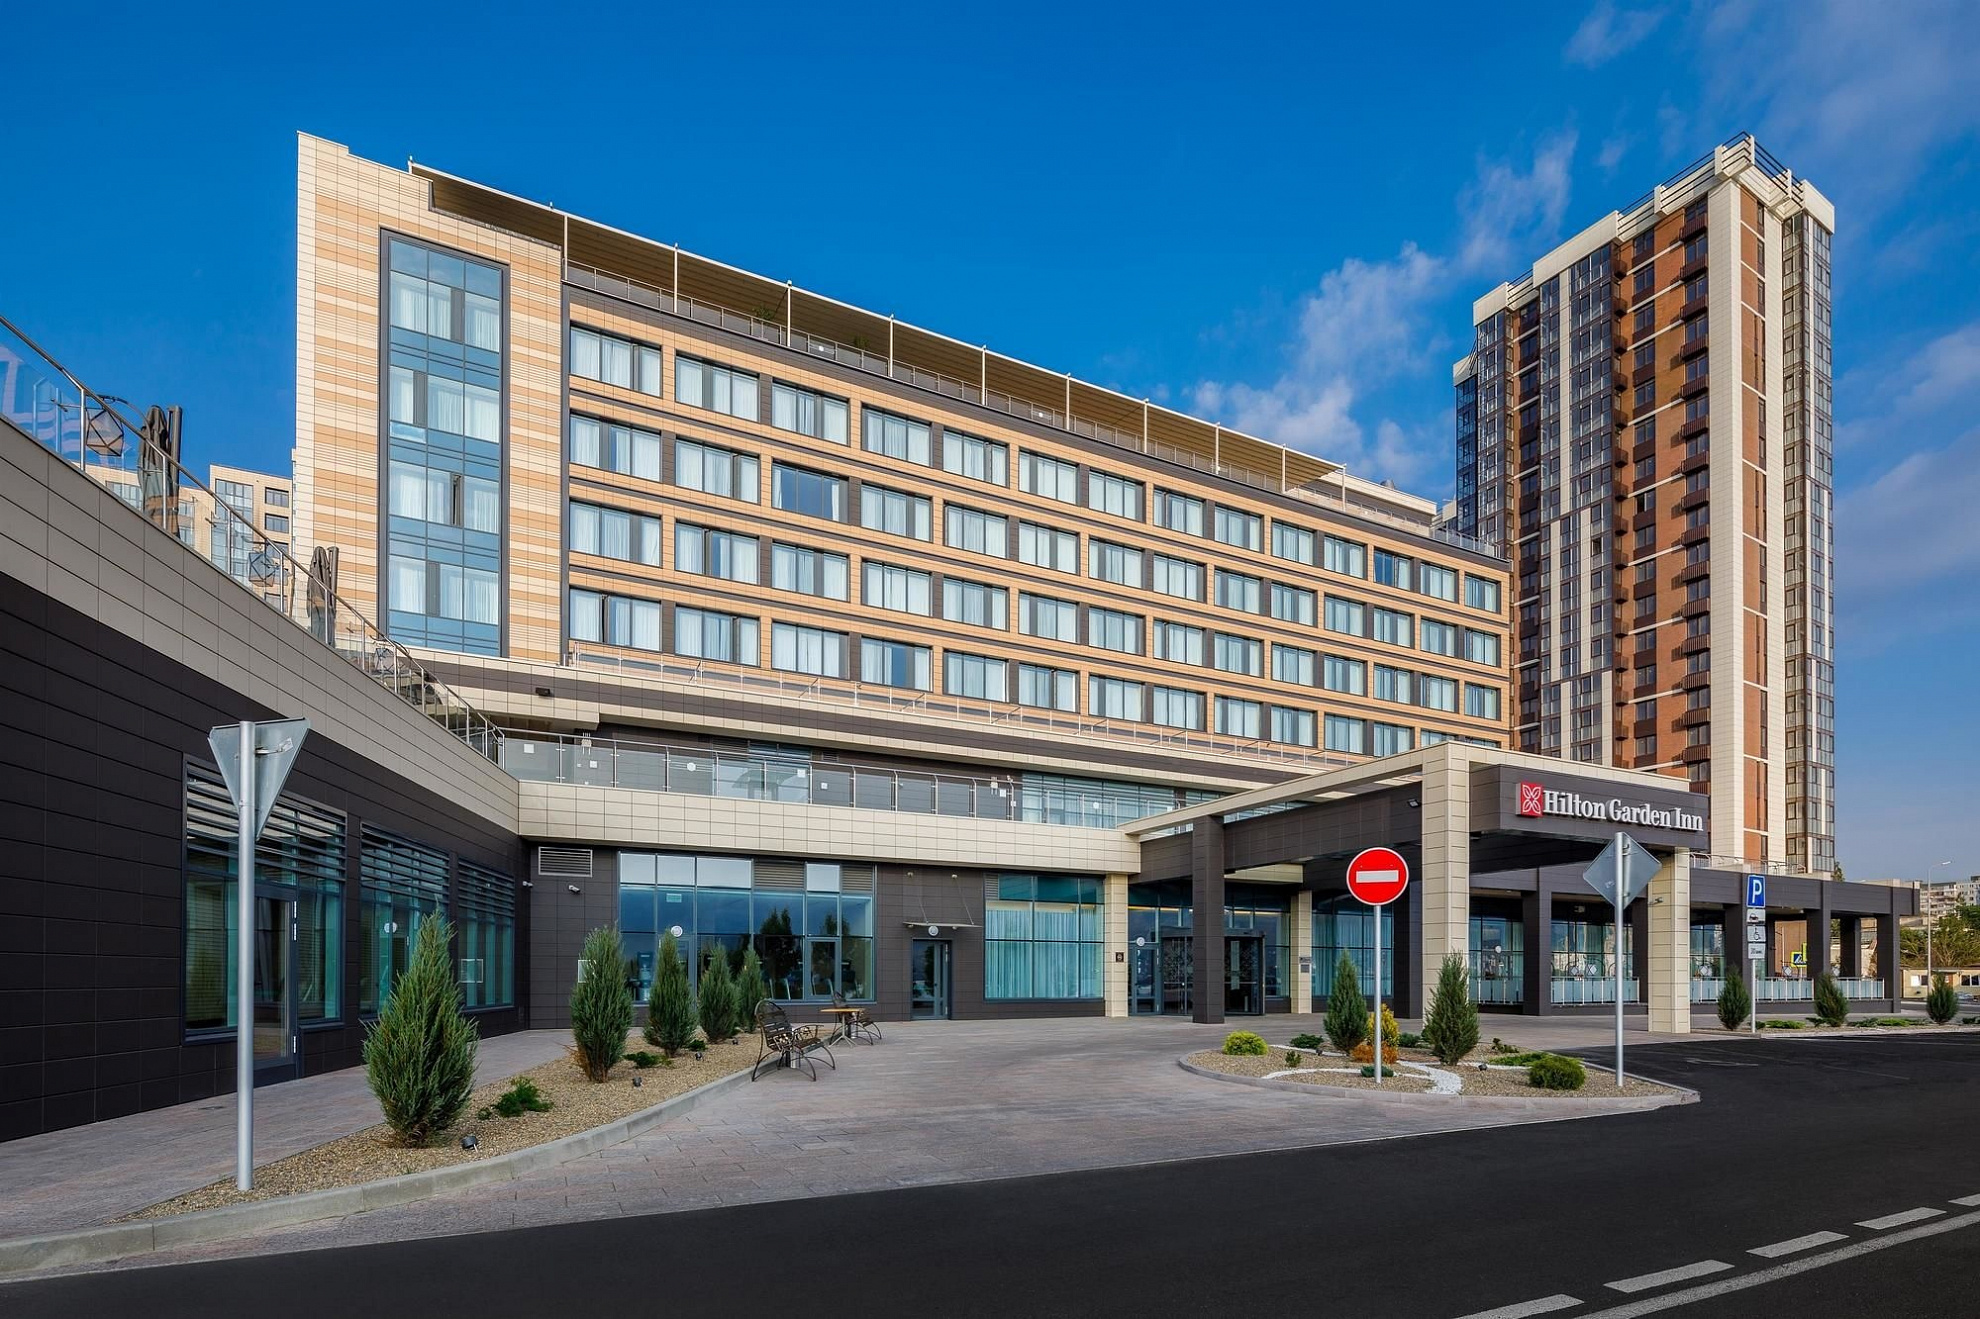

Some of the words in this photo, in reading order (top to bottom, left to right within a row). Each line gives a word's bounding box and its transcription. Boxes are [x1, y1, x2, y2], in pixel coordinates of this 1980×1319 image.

[1543, 790, 1607, 820] Hilton
[1609, 799, 1671, 827] Garden
[1674, 807, 1704, 831] Inn
[1751, 879, 1763, 904] P
